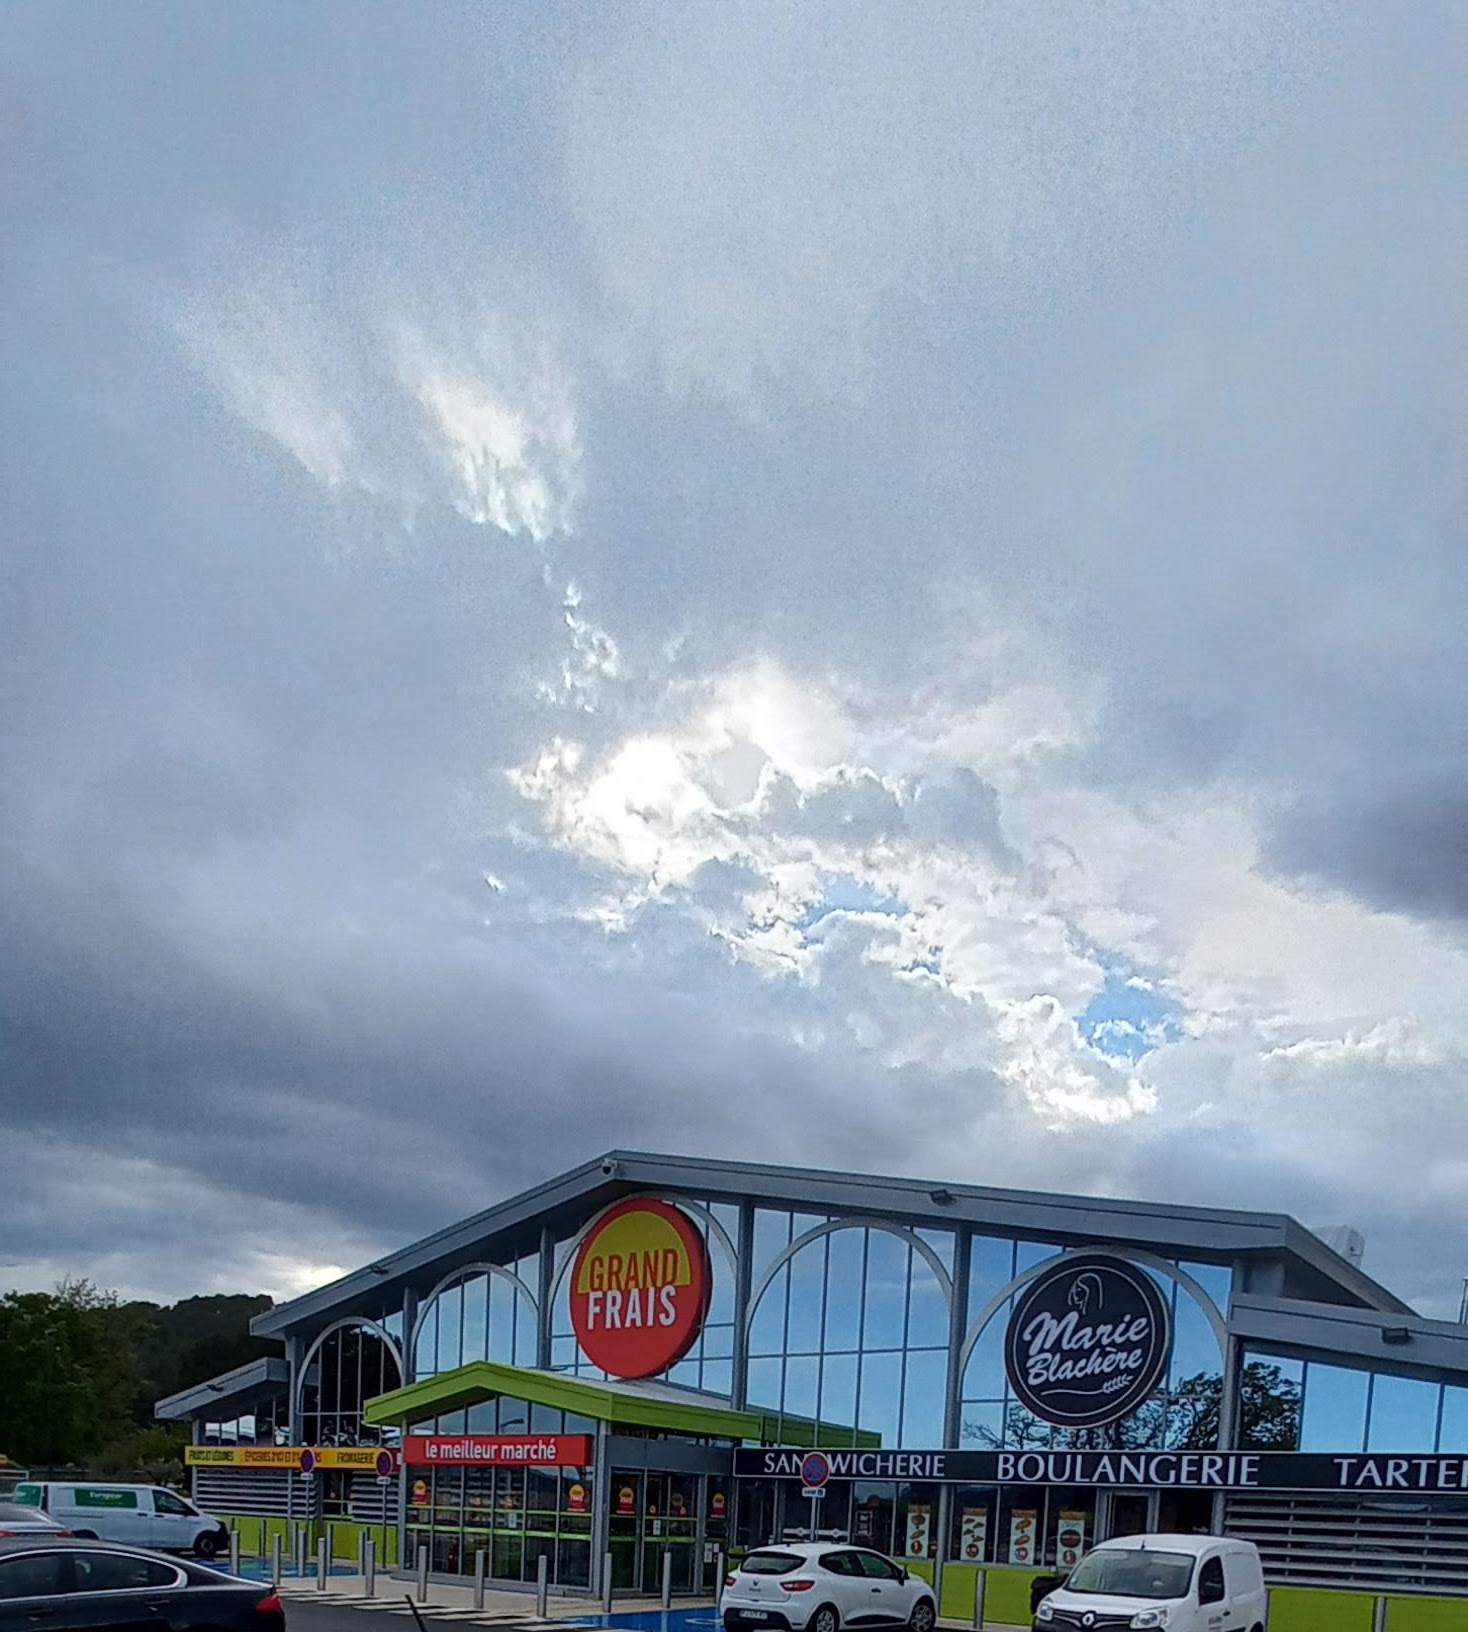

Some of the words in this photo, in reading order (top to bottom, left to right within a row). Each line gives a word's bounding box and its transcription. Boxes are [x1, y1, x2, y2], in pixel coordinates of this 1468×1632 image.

[590, 1249, 678, 1291] GRAND
[587, 1284, 677, 1330] FRAIS
[1023, 1311, 1149, 1356] Marie
[1027, 1346, 1143, 1386] Blachère
[425, 1441, 439, 1460] le
[440, 1441, 499, 1461] meilleur
[500, 1437, 557, 1461] marché
[764, 1452, 946, 1478] SANWICHERIE
[997, 1453, 1261, 1486] BOULANGERIE
